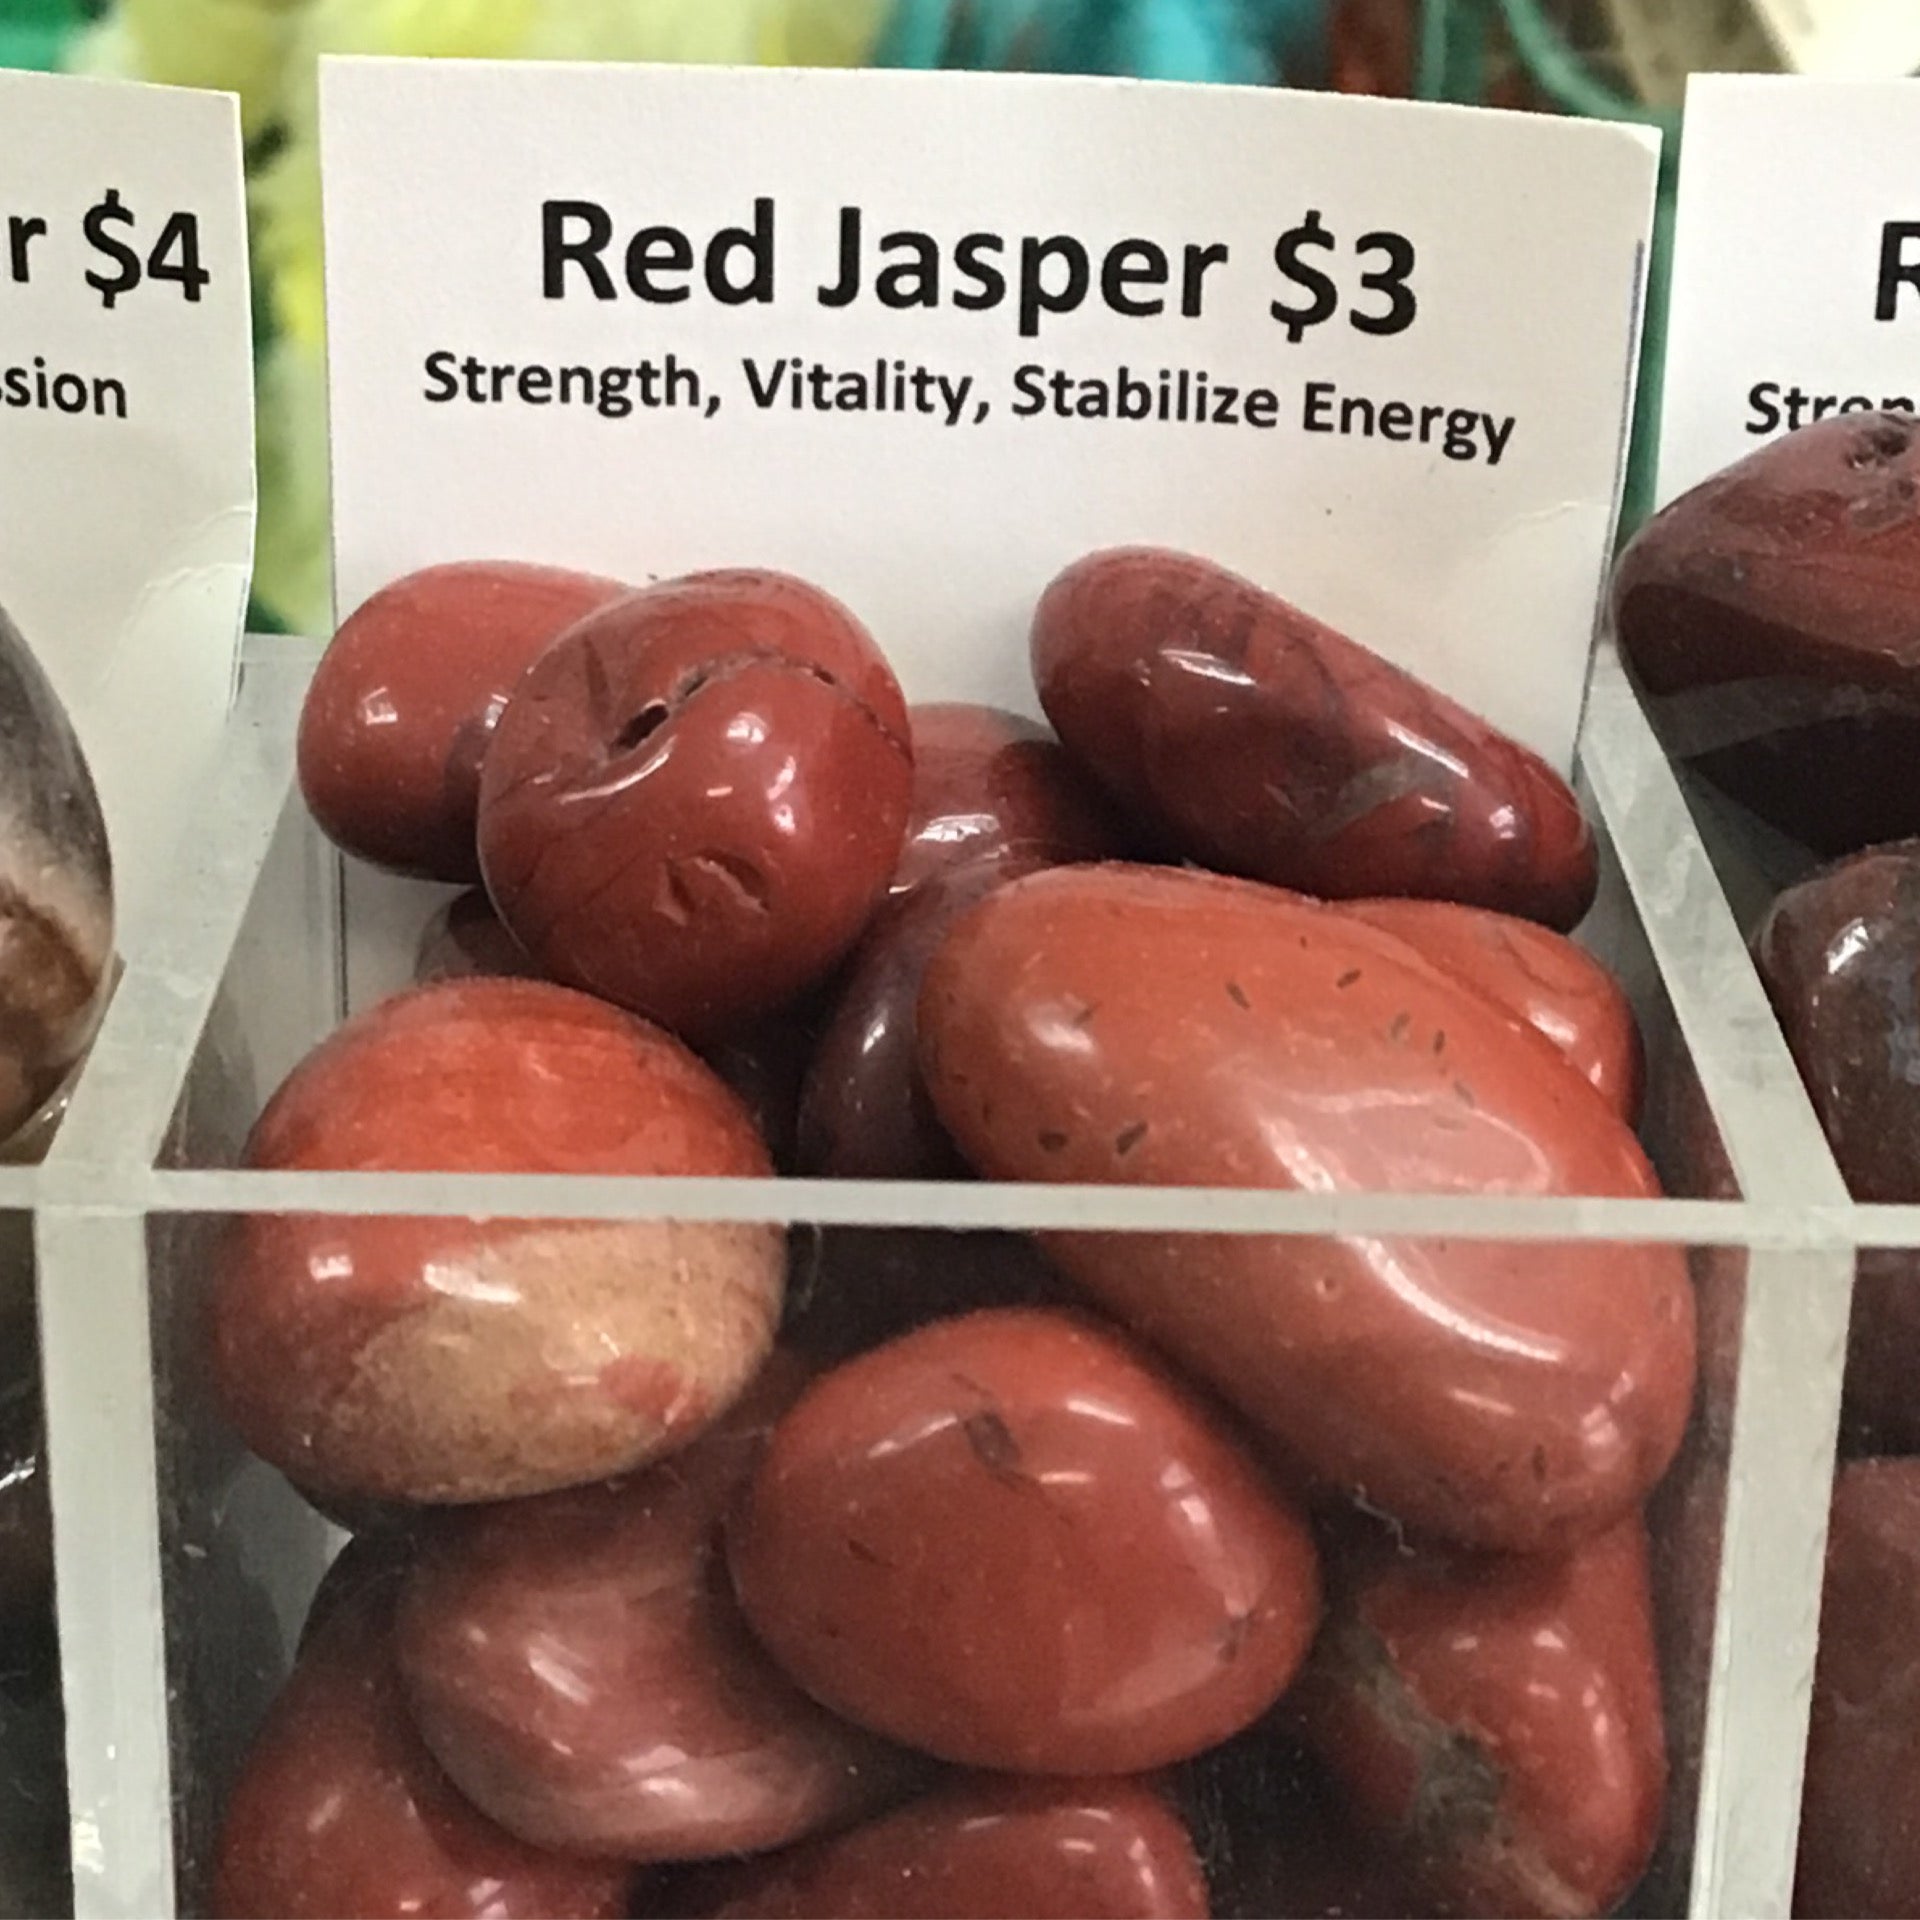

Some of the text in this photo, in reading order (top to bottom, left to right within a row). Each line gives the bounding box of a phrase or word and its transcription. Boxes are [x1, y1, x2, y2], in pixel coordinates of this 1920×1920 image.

[82, 188, 210, 309] $4
[541, 197, 1418, 344] Red Jasper $3
[0, 356, 128, 419] sion
[424, 351, 1517, 465] Strength, Vitality, Stabilize Energy
